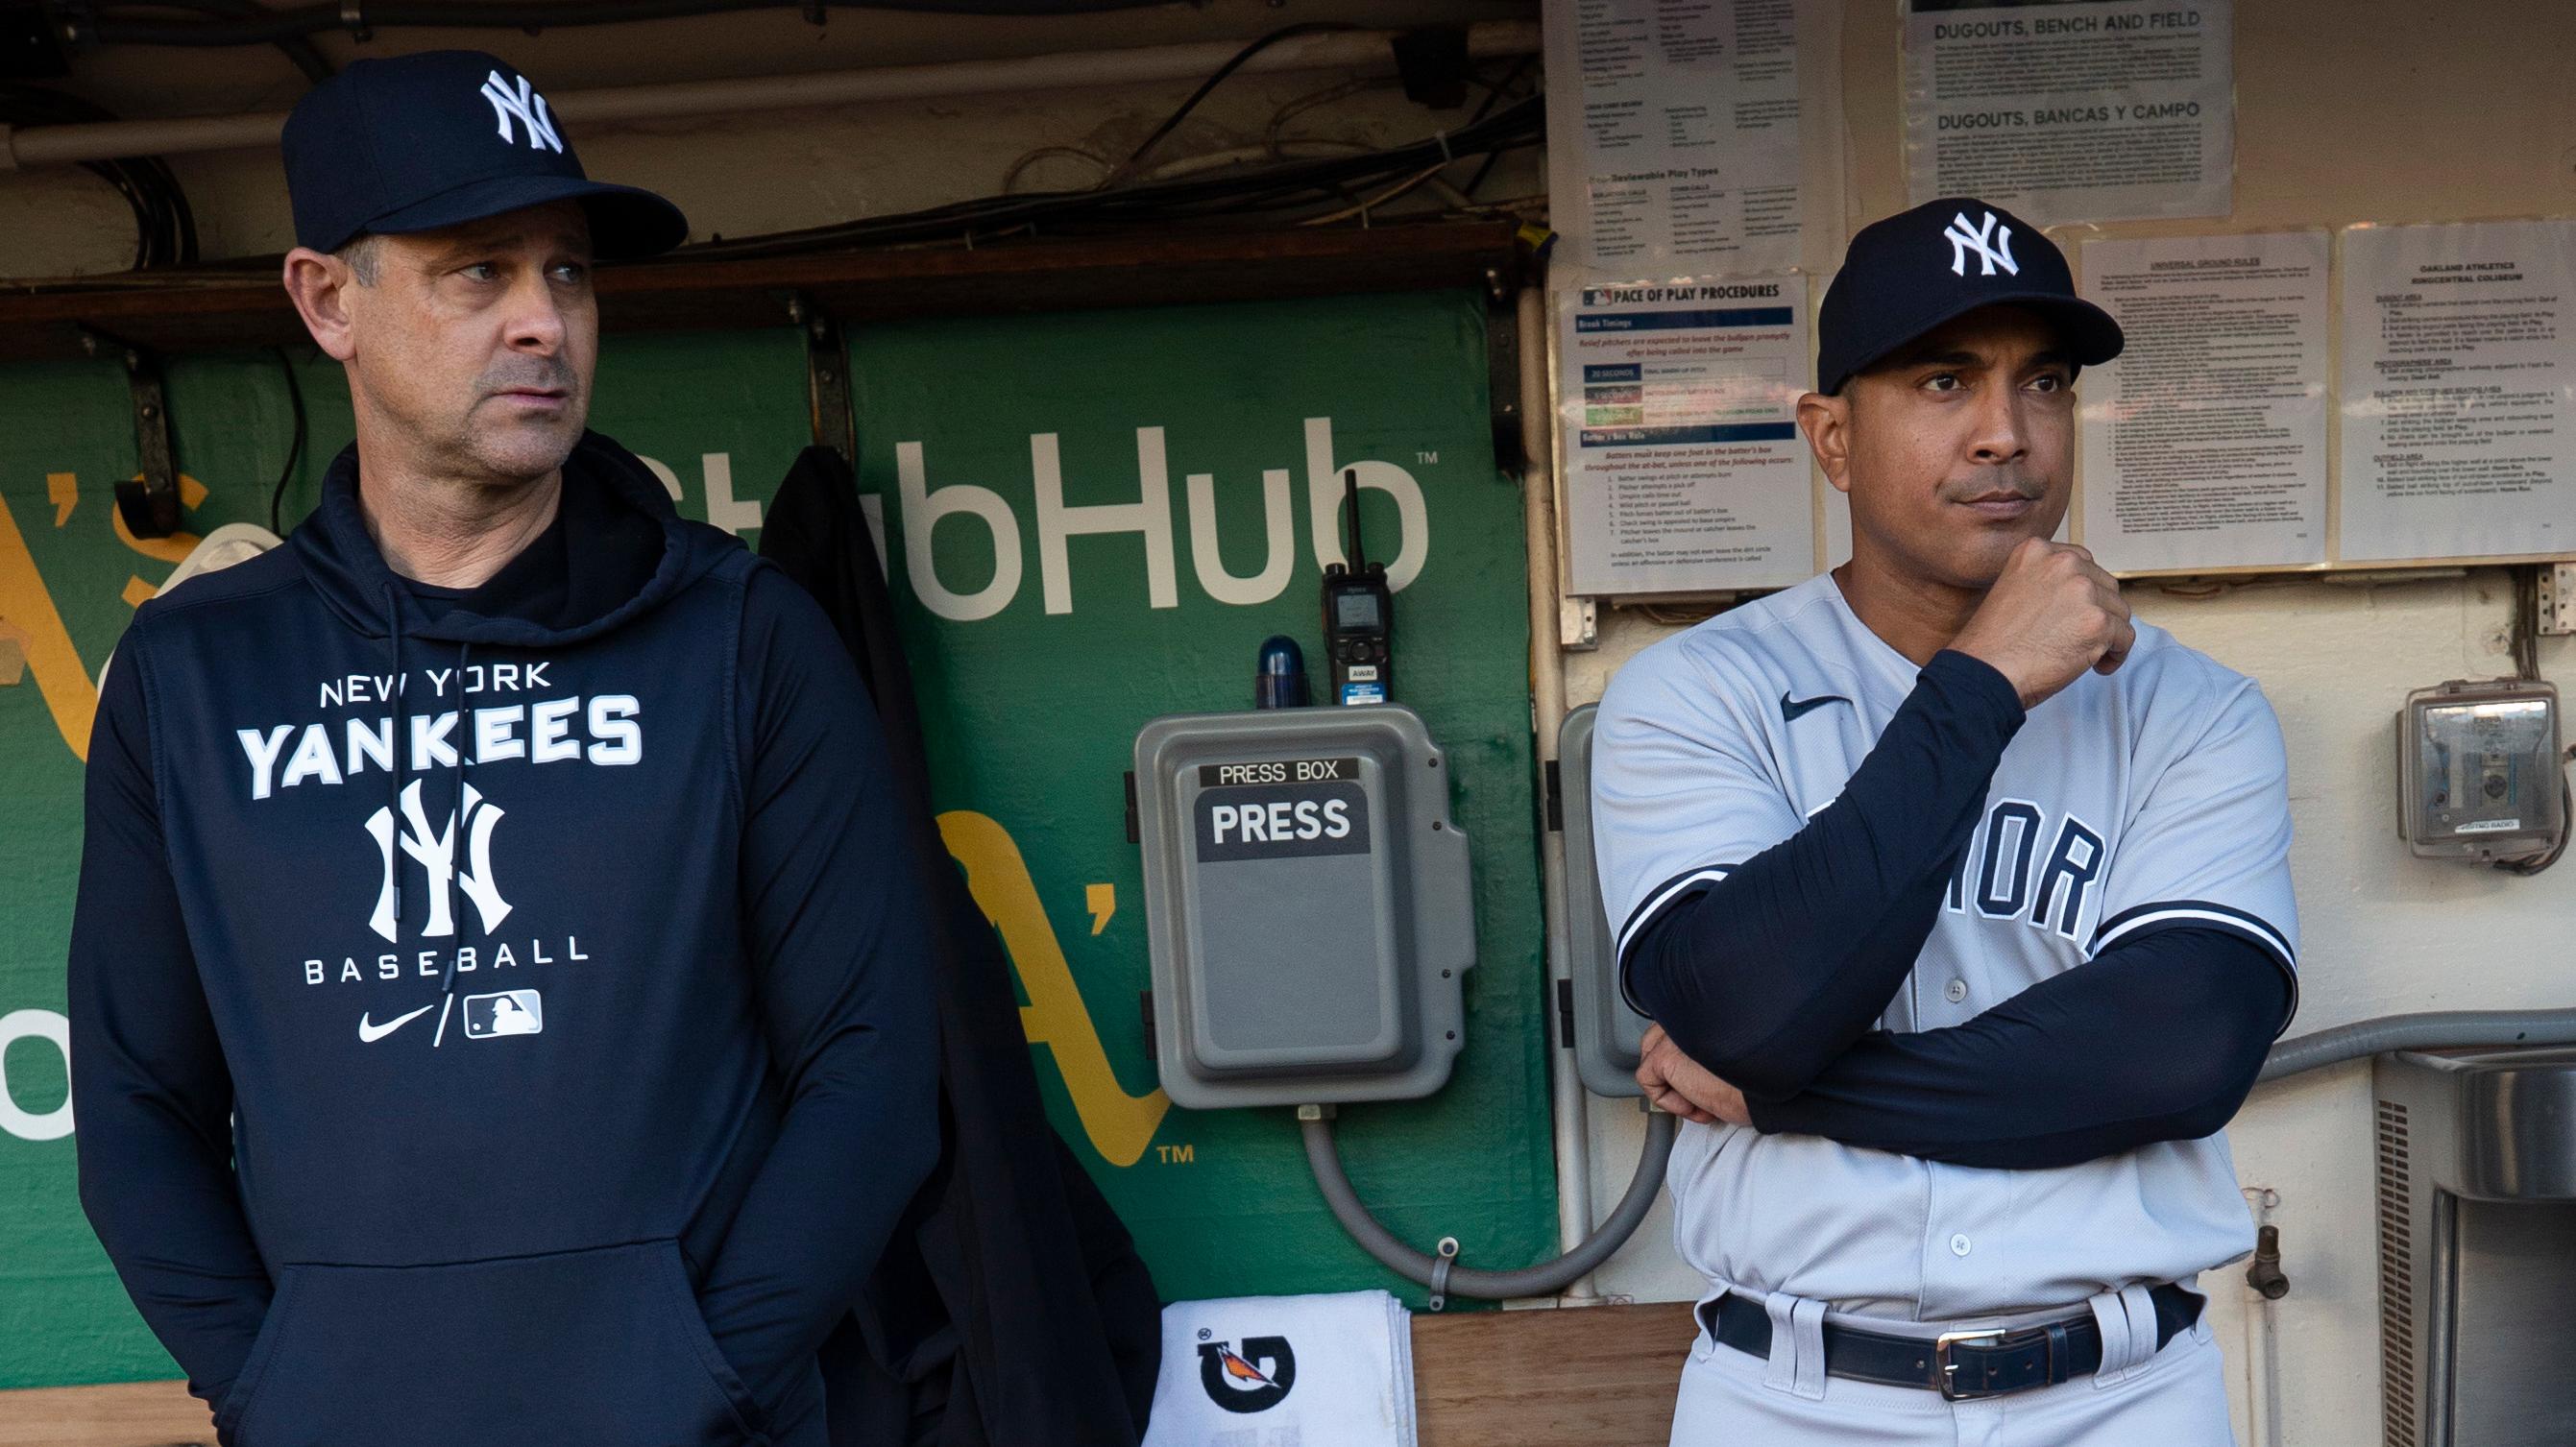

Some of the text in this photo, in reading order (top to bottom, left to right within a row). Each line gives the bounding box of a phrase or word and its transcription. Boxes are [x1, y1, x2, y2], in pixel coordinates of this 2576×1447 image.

[1934, 11, 2200, 39] DUGOUTS, BENCH AND FIELD
[1937, 101, 2200, 130] DUGOUTS, BANCAS Y CAMPO
[1944, 211, 2019, 277] NY
[1615, 284, 1780, 303] PACE OF PLAY PROCEDURES
[321, 662, 551, 708] NEW YORK
[236, 694, 643, 801] YANKEES
[1220, 760, 1340, 784] PRESS BOX
[1212, 798, 1350, 845] PRESS
[304, 935, 589, 986] BASEBALL
